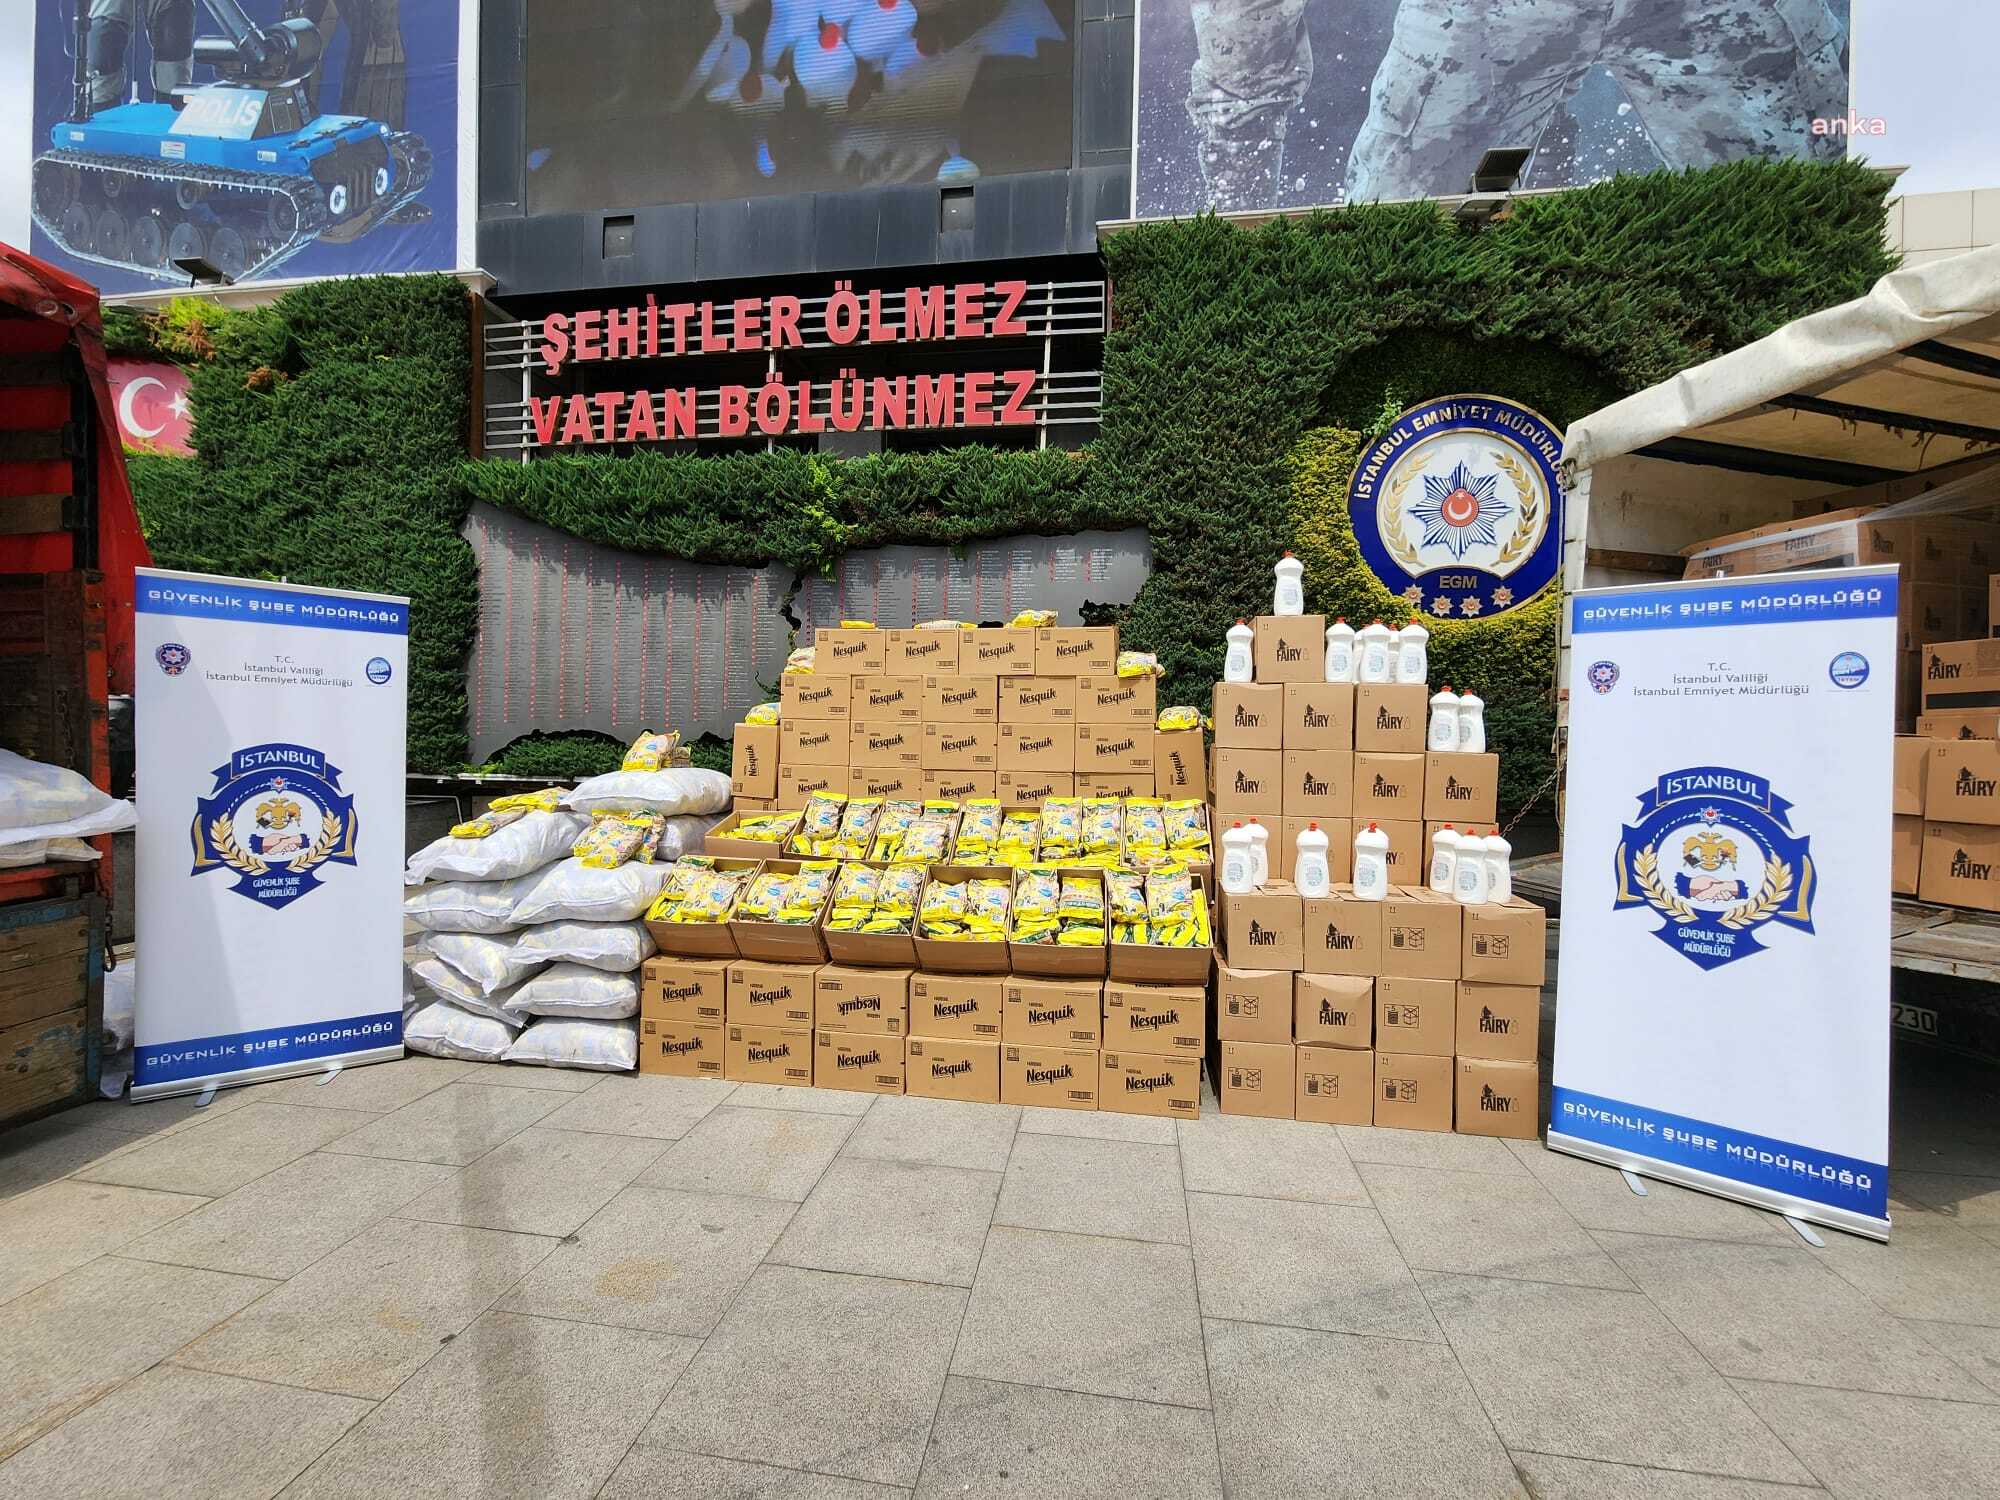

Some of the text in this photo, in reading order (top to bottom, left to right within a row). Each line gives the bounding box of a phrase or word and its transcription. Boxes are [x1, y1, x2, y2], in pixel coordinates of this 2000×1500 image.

[190, 95, 261, 125] POLİS
[541, 280, 1027, 376] ŞEHİTLER ÖLMEZ
[530, 368, 1036, 444] VATAN BÖLÜNMEZ
[1354, 428, 1413, 499] İSTANBUL
[1412, 404, 1492, 432] EMNİYET
[1439, 575, 1477, 589] EGM
[148, 589, 399, 623] GÜVENLİK ŞUBE MÜDÜRLÜĞÜ
[1583, 588, 1882, 620] GÜVENLİK ŞUBE MÜDÜRLÜĞÜ
[833, 640, 867, 657] Nesquik
[905, 640, 941, 657] Nesquik
[978, 642, 1015, 659] Nesquik
[1056, 640, 1094, 657] Nesquik
[244, 662, 286, 674] İstanbul
[274, 655, 295, 664] T.C.
[1708, 662, 1732, 672] T.C.
[206, 670, 353, 688] İstanbul Emniyet Müdürlüğü
[1673, 672, 1769, 685] İstanbul Valiliği
[799, 687, 832, 702] Nesquik
[870, 689, 905, 706] Nesquik
[941, 688, 978, 705] Nesquik
[1019, 688, 1056, 705] Nesquik
[1097, 687, 1135, 705] Nesquik
[1633, 683, 1809, 698] İstanbul Emniyet Müdürlüğü
[800, 732, 831, 747] Nesquik
[868, 734, 904, 750] Nesquik
[941, 735, 977, 752] Nesquik
[1019, 737, 1053, 752] Nesquik
[1095, 738, 1135, 756] Nesquik
[240, 749, 321, 769] İSTANBUL
[748, 744, 758, 777] Nesquik
[1169, 751, 1188, 786] Nesquik
[867, 780, 902, 796] Nesquik
[939, 782, 976, 798] Nesquik
[1016, 785, 1054, 801] Nesquik
[1665, 774, 1764, 800] İSTANBUL
[662, 982, 703, 1001] Nesquik
[749, 985, 792, 1004] Nesquik
[837, 995, 881, 1016] Nesquik
[933, 998, 978, 1018] Nesquik
[1028, 1004, 1075, 1025] Nesquik
[1130, 1008, 1179, 1030] Nesquik
[146, 1021, 393, 1067] GÜVENLİK ŞUBE MÜDÜRLÜĞÜ
[661, 1037, 703, 1055] Nesquik
[748, 1043, 790, 1062] Nesquik
[836, 1049, 881, 1069] Nesquik
[931, 1060, 972, 1078] Nesquik
[1026, 1064, 1073, 1084] Nesquik
[1125, 1072, 1175, 1093] Nesquik
[1563, 1100, 1873, 1190] GÜVENLİK ŞUBE MÜDÜRLÜĞÜ
